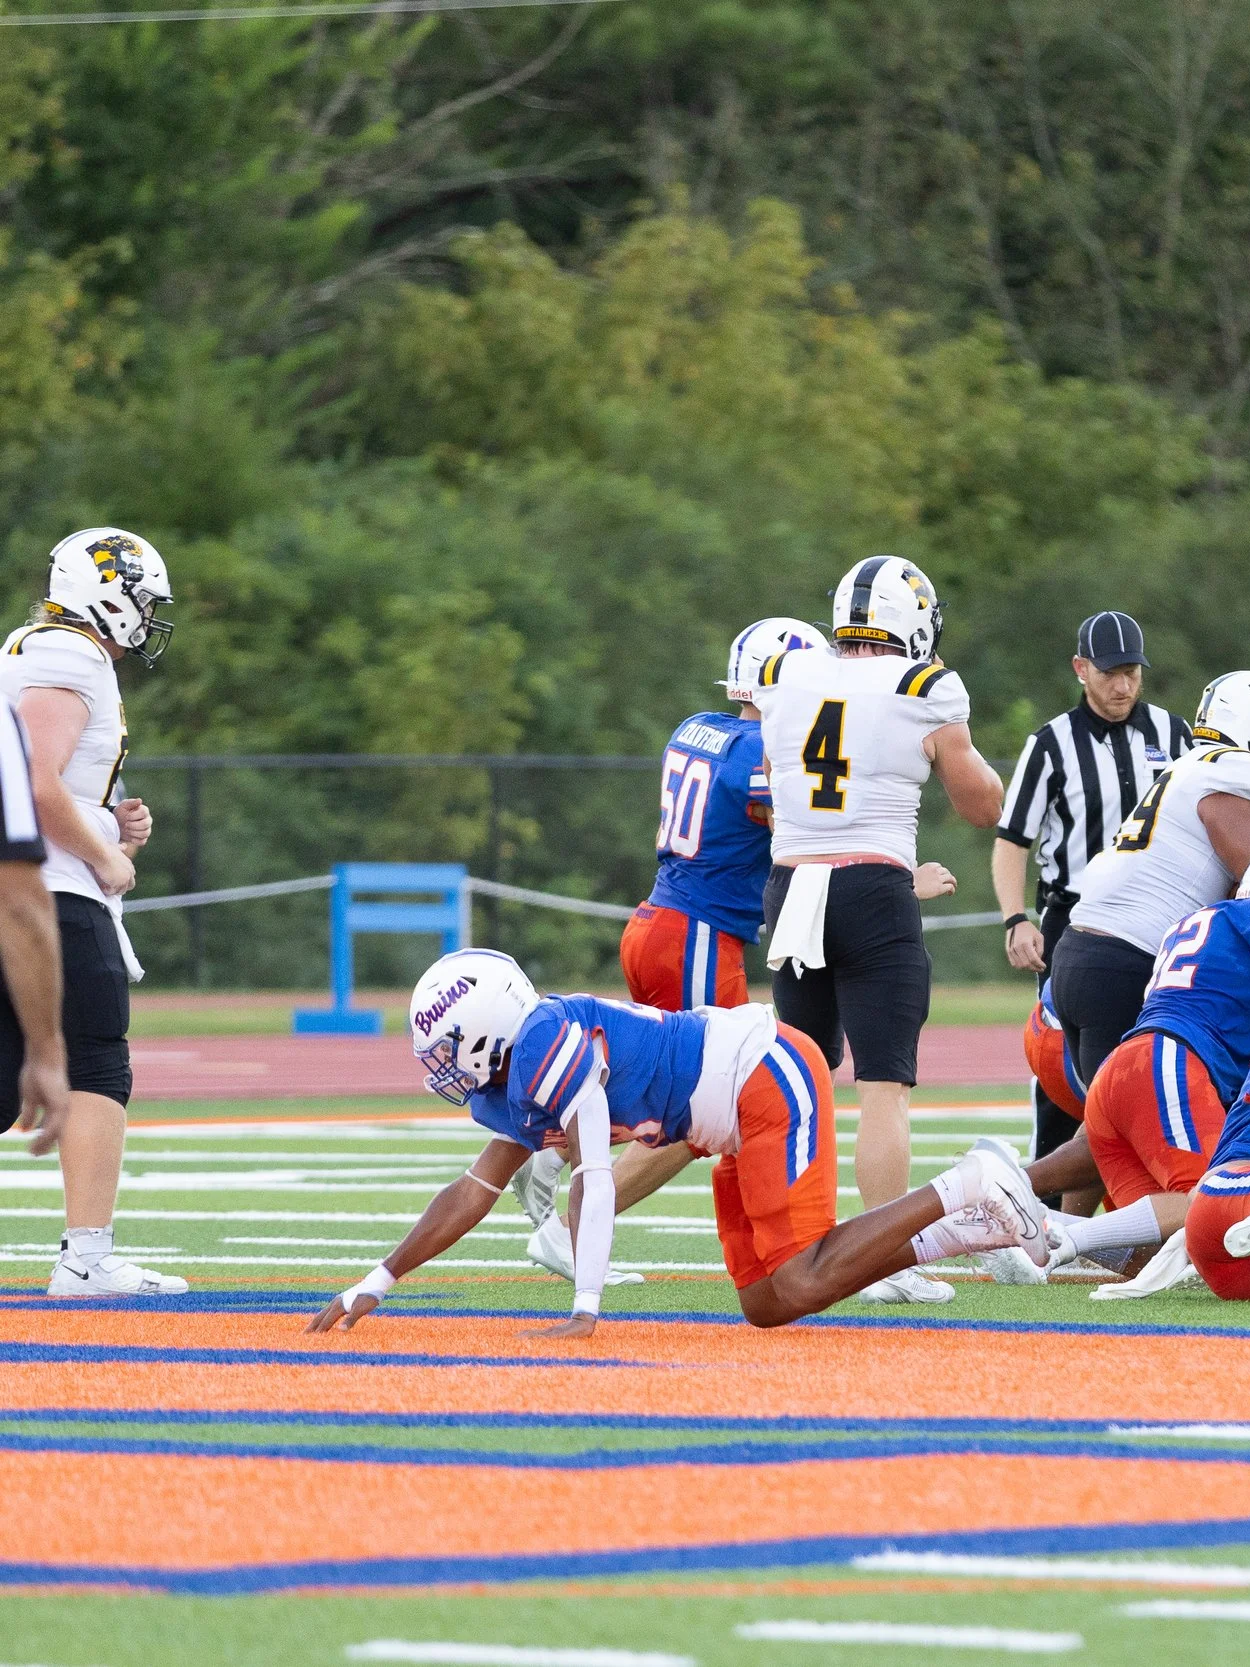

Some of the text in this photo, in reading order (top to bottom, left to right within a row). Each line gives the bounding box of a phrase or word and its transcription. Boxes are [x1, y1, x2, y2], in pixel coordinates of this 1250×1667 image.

[836, 627, 889, 641] MOUNTAINEERS
[801, 698, 850, 812] 4
[656, 749, 712, 861] 50
[415, 979, 469, 1037] Bruins
